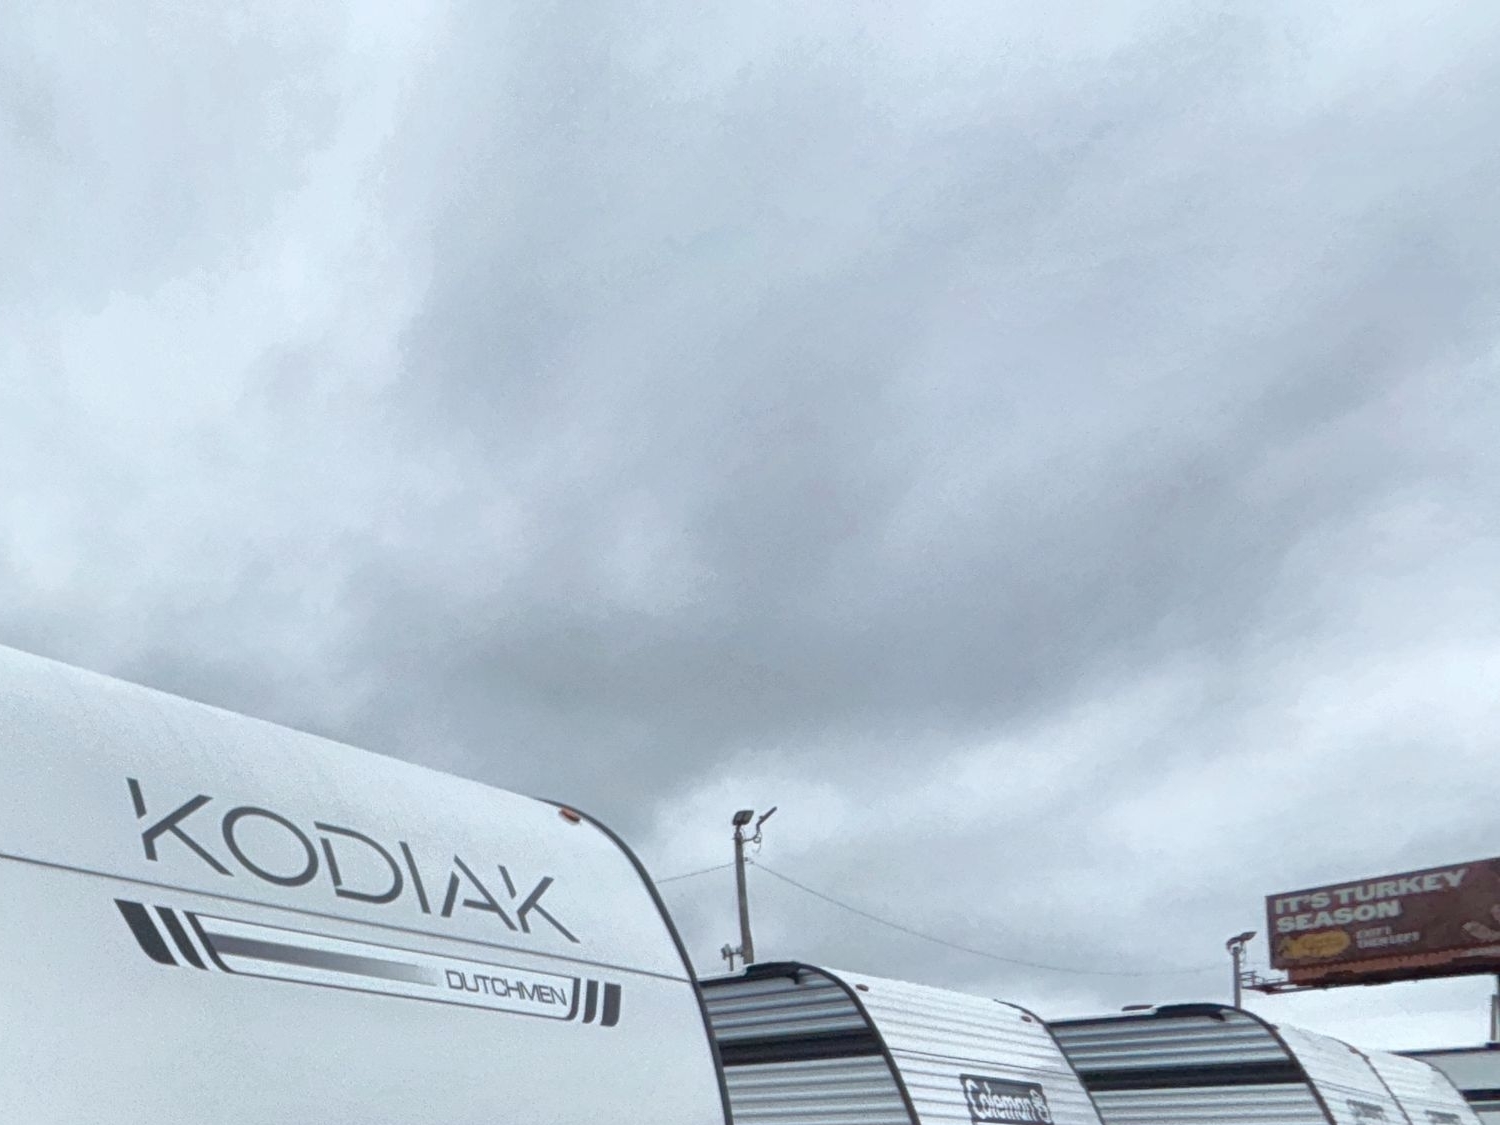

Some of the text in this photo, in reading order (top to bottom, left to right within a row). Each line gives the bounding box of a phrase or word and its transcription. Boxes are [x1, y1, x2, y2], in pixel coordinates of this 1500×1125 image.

[126, 777, 580, 943] KODIAK
[1275, 868, 1467, 915] IT'S TURKEY
[1277, 900, 1402, 933] SEASON
[445, 969, 567, 1006] DUTCHMEN
[965, 1079, 1038, 1122] Coleman
